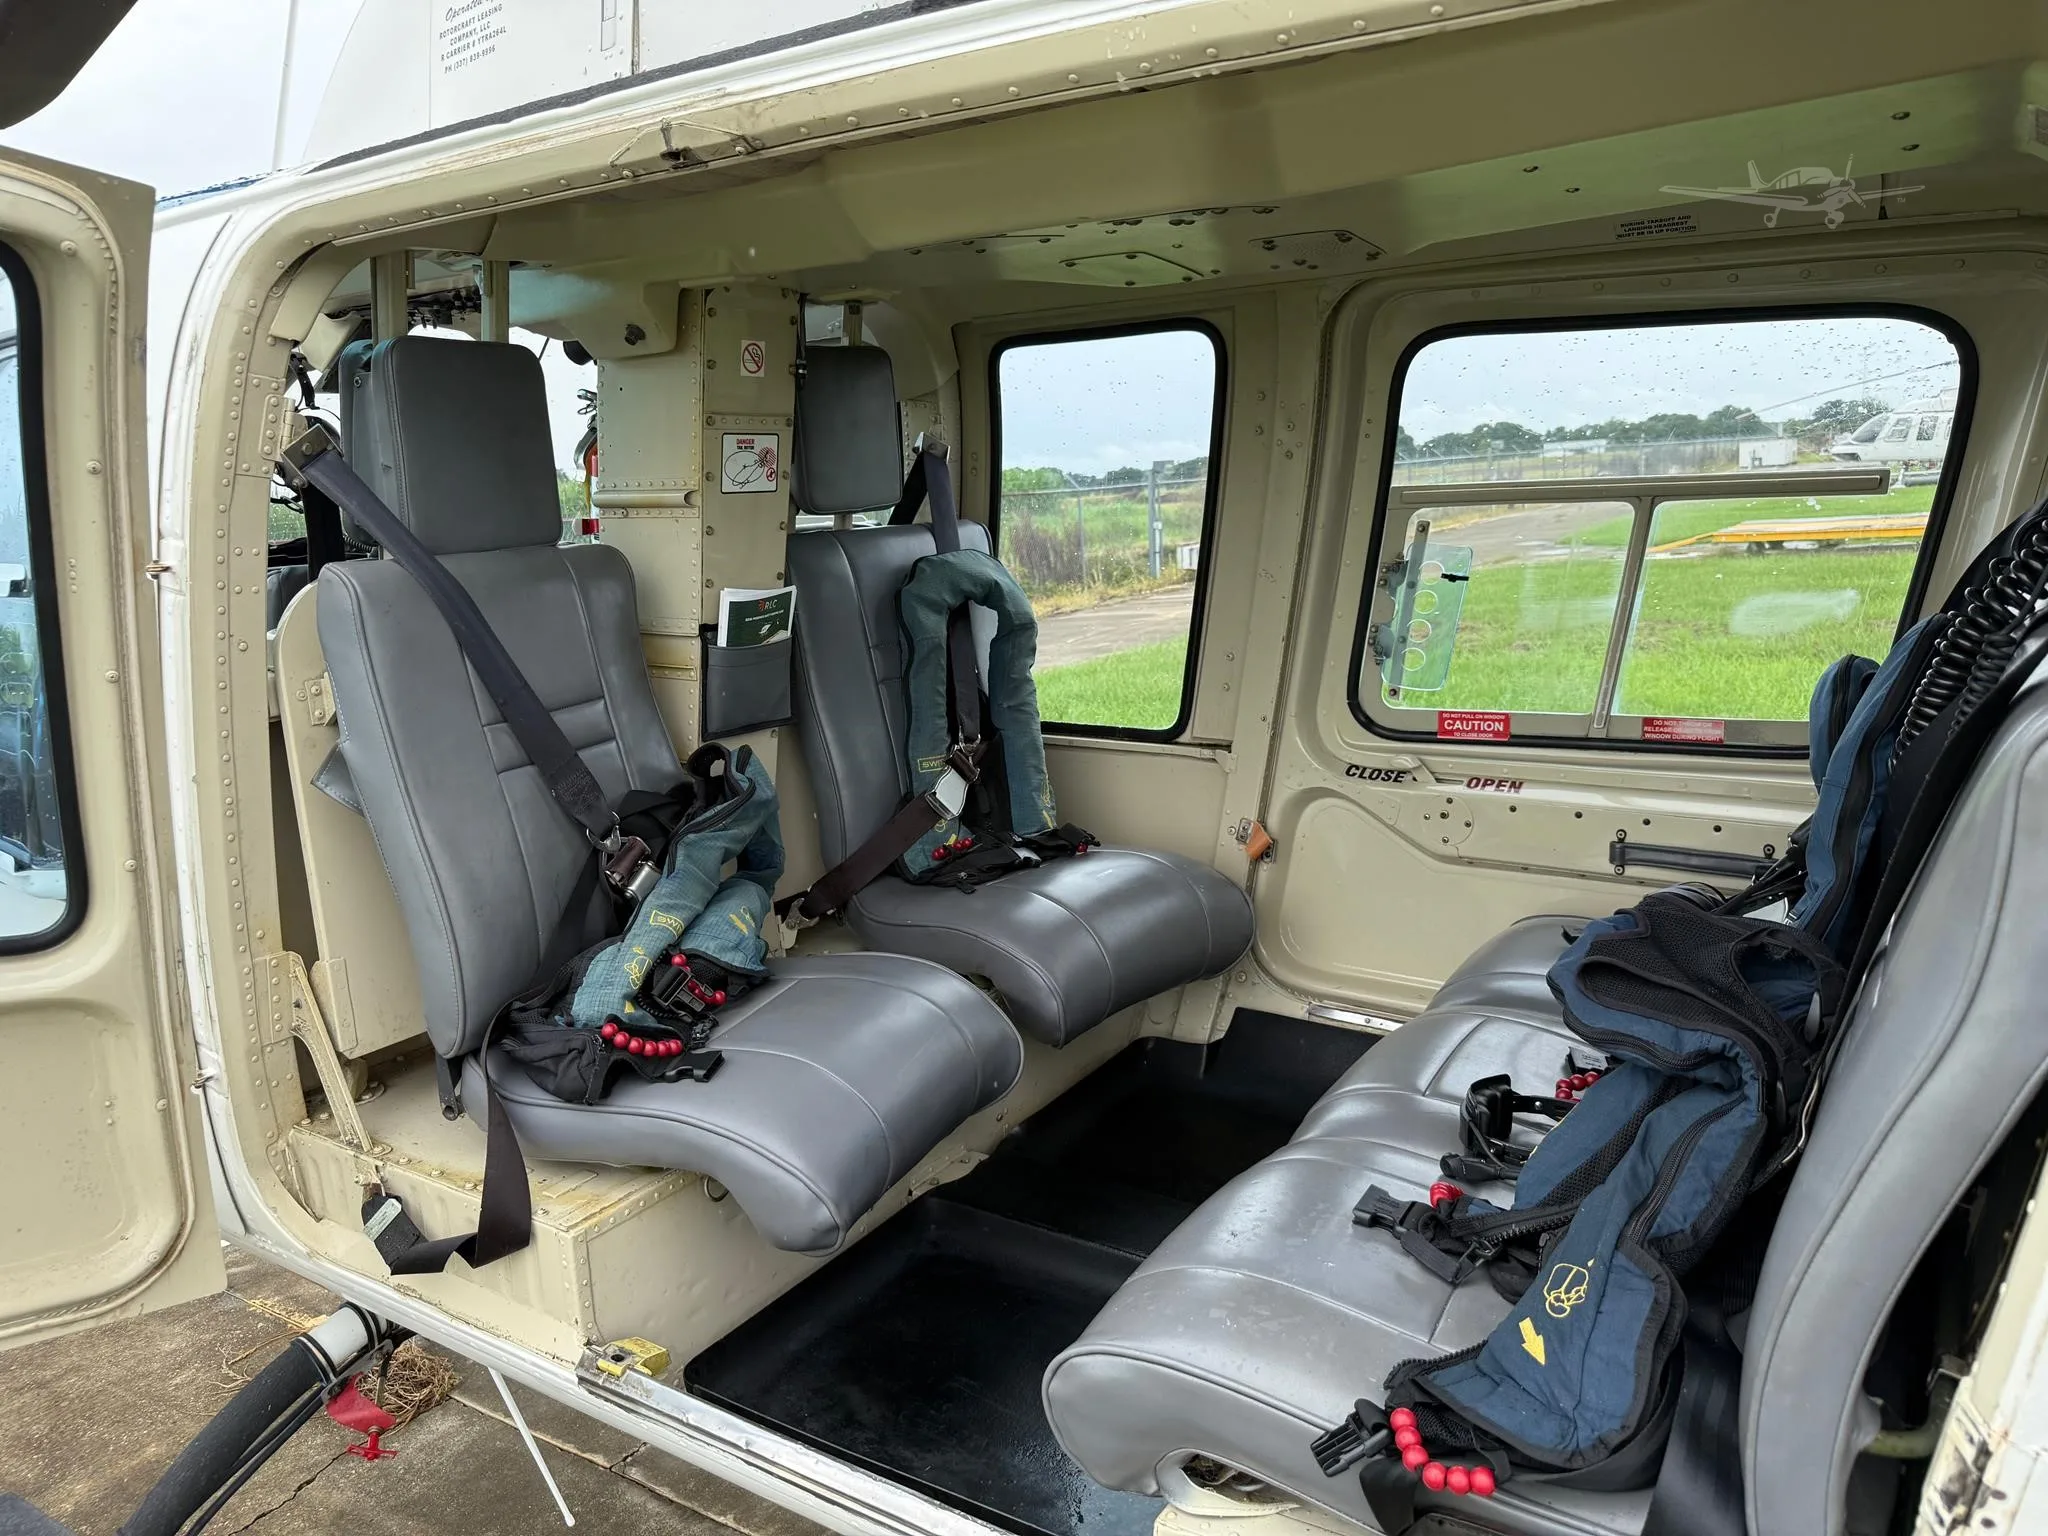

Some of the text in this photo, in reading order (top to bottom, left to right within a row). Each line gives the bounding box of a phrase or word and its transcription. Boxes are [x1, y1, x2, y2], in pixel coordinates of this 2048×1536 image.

[439, 3, 503, 40] ROTORCRAFT LEASING
[480, 21, 491, 32] LLC
[446, 42, 471, 59] CARRIER
[1444, 719, 1504, 731] CAUTION
[1345, 764, 1525, 794] CLOSE OPEN
